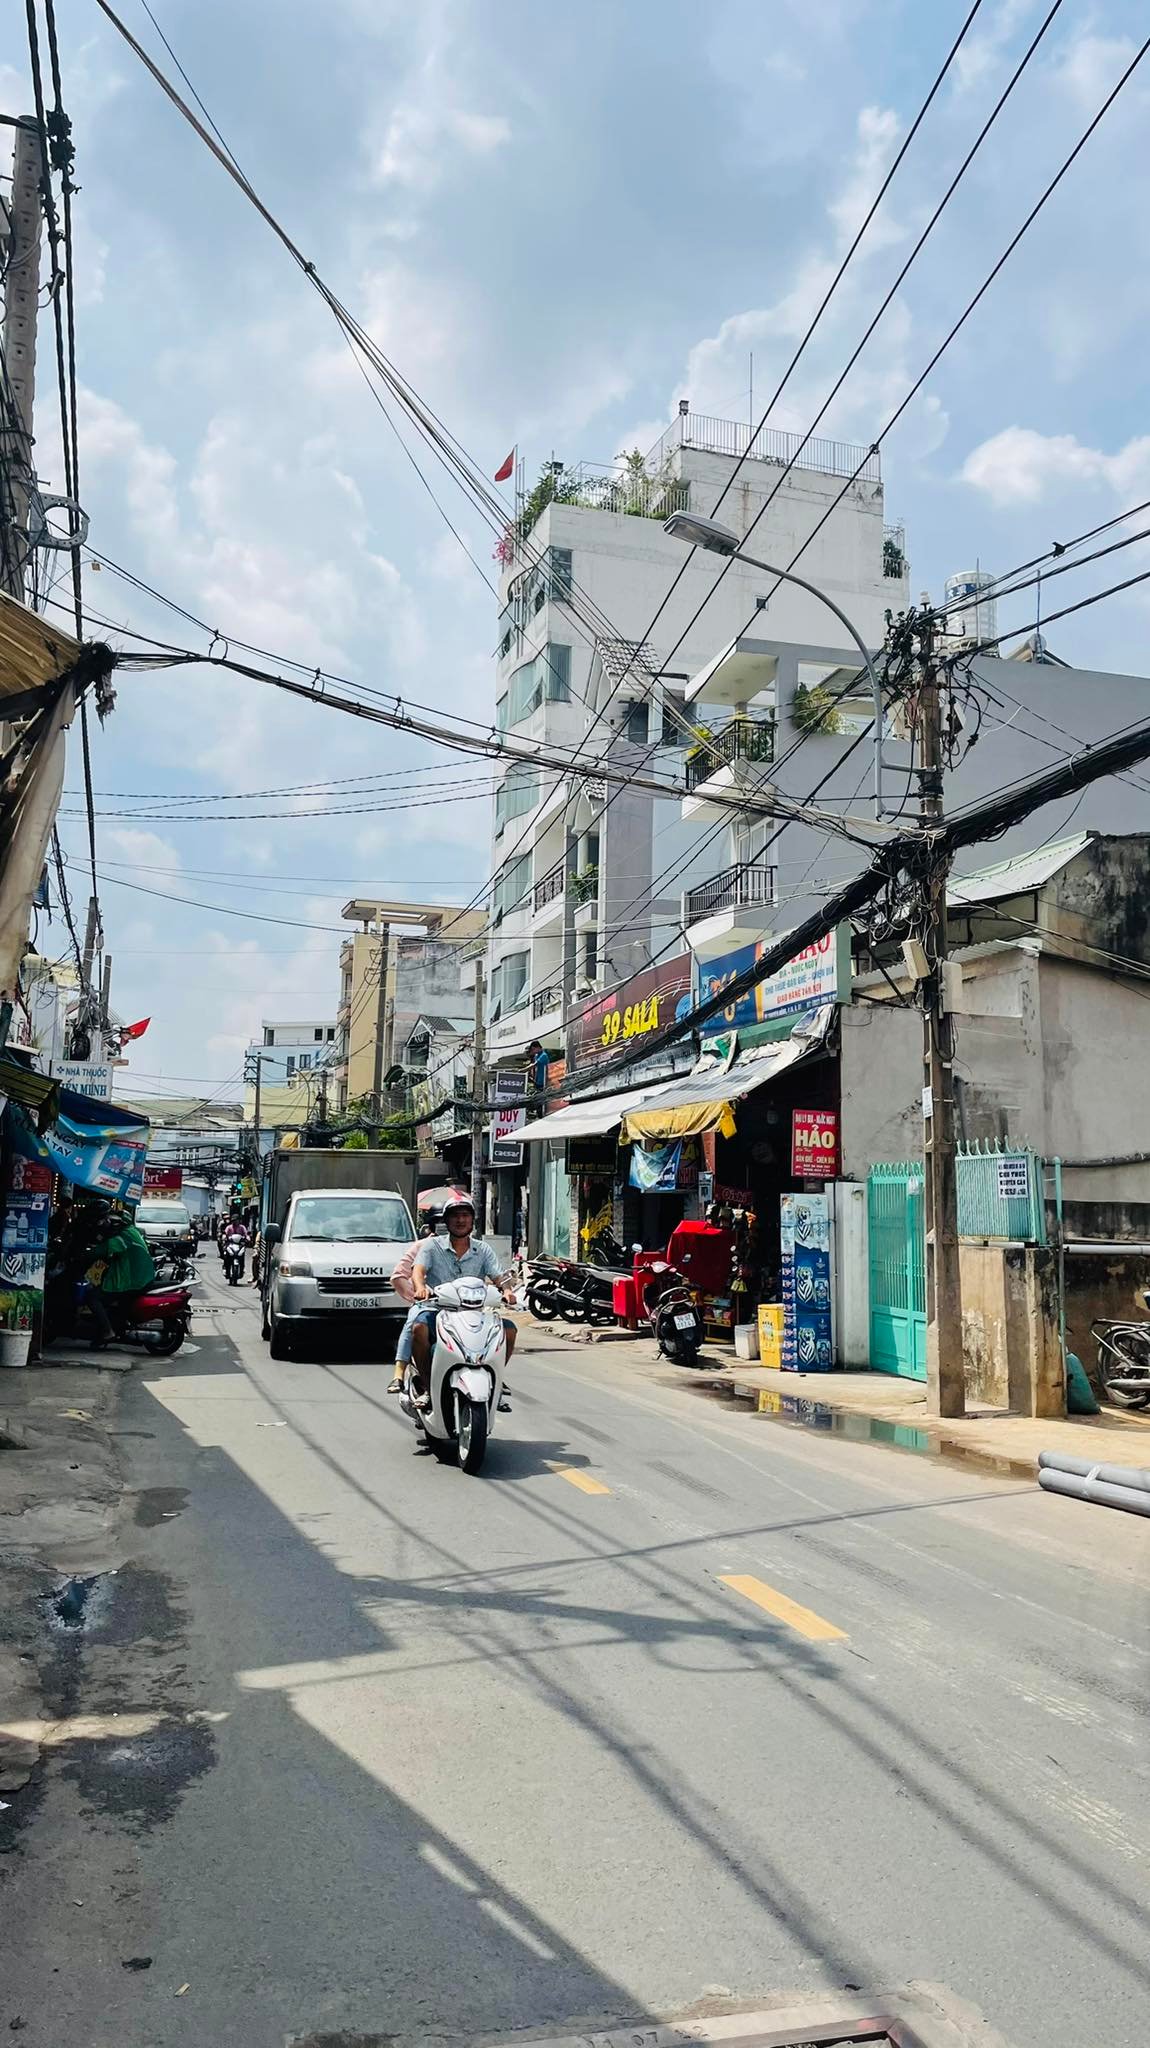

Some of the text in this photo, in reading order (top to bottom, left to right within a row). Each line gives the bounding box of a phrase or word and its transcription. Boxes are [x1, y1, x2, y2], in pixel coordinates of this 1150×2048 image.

[601, 1010, 621, 1046] 39
[622, 995, 659, 1039] SALA
[499, 1110, 519, 1123] DUY
[795, 1124, 835, 1149] HẢO
[333, 1267, 383, 1275] SUZUKI
